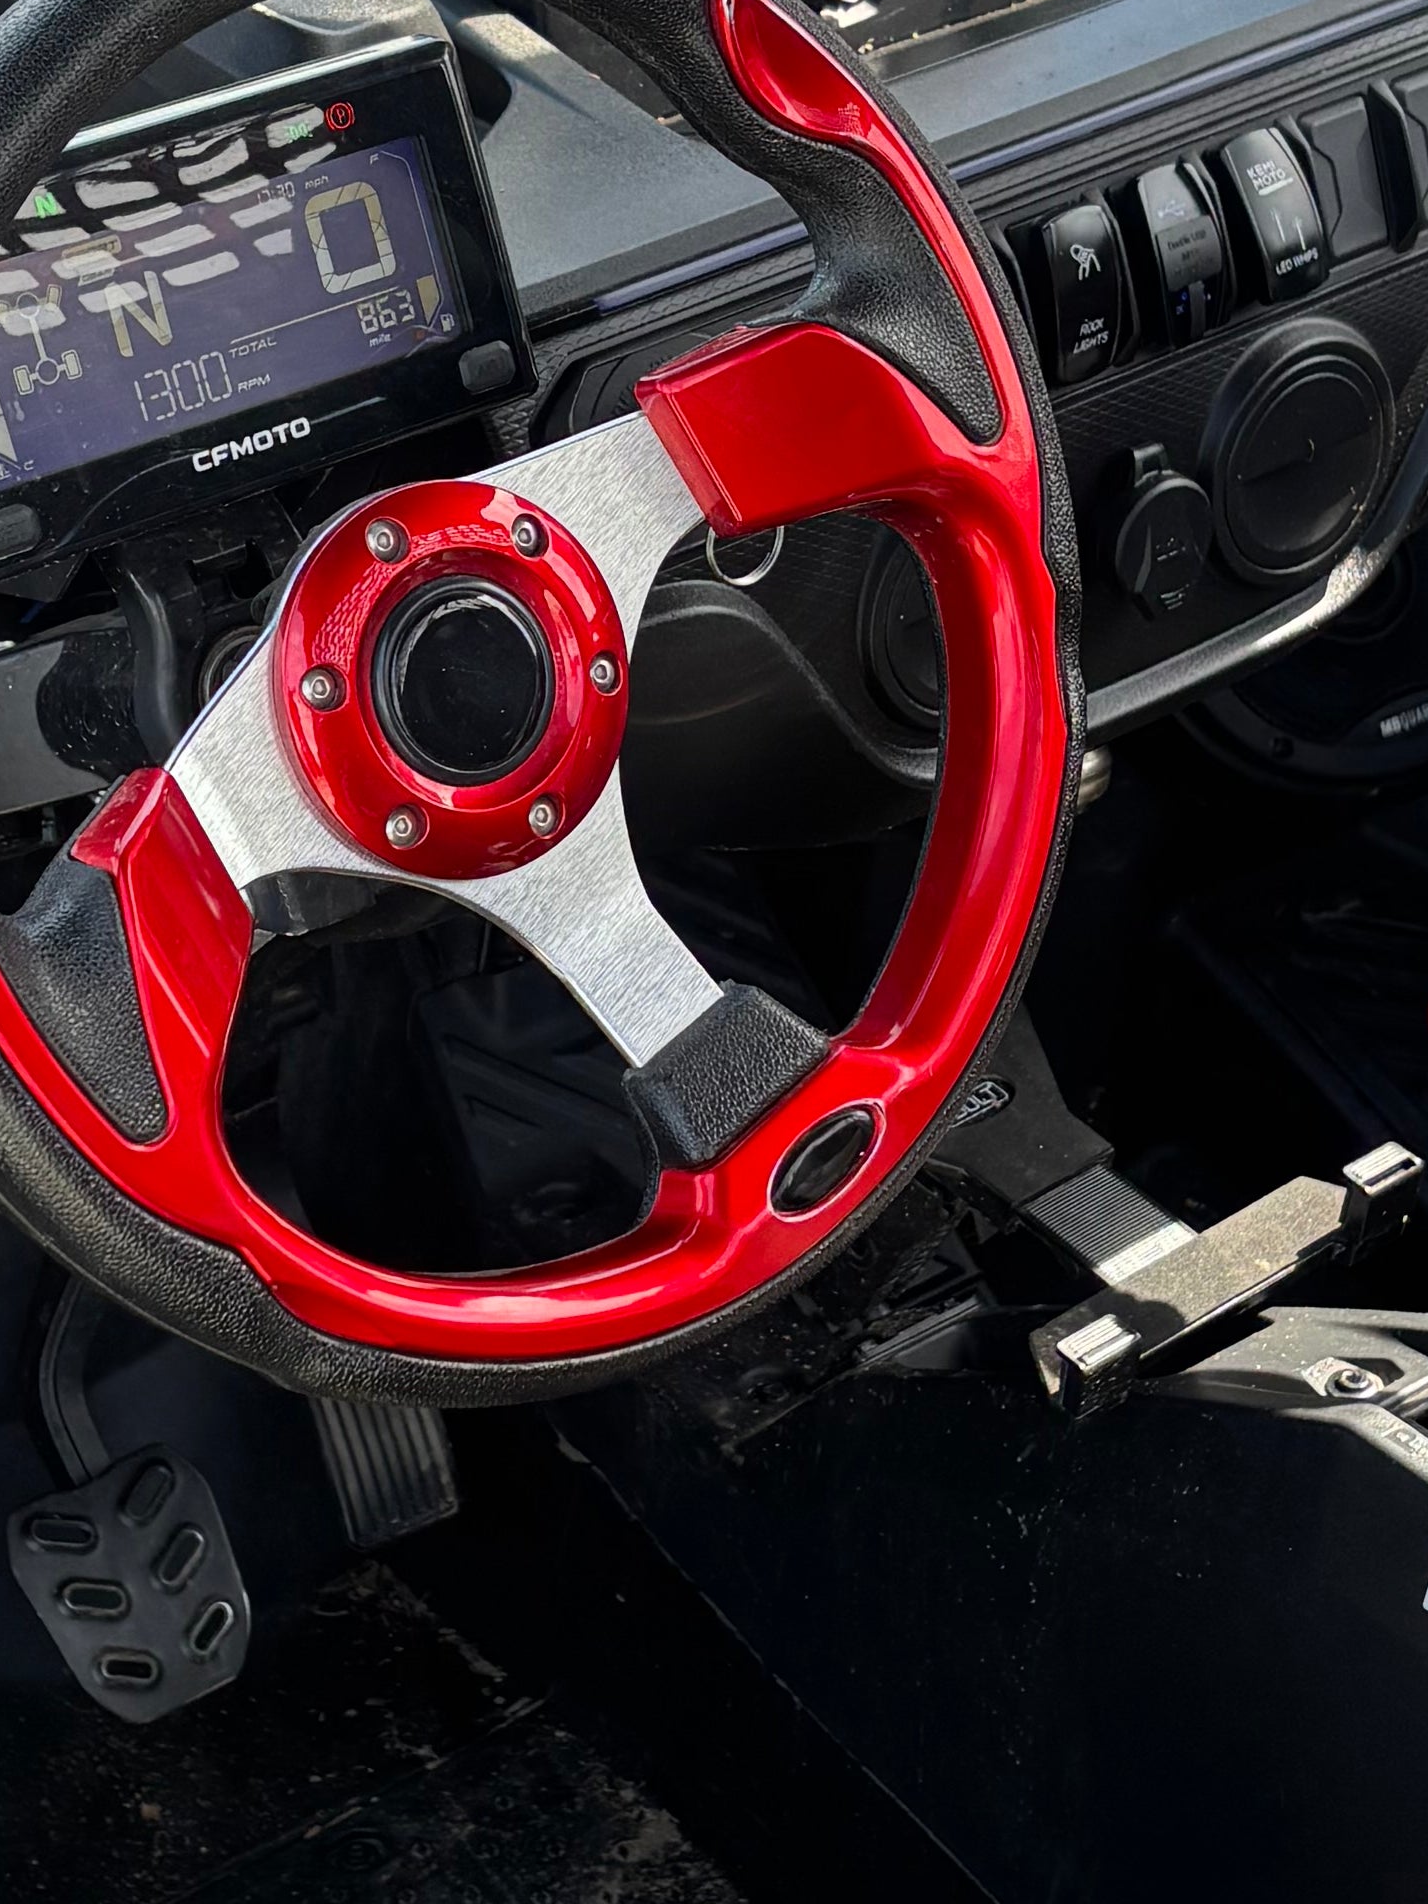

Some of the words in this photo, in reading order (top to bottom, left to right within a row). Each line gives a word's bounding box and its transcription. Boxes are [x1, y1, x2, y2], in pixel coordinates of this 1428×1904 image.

[1247, 160, 1276, 179] KEMI
[1252, 168, 1286, 190] MOTO
[305, 175, 329, 190] mph
[33, 192, 58, 219] N
[305, 181, 396, 293] 0
[104, 270, 172, 357] N
[356, 289, 415, 335] 863
[228, 336, 277, 359] TOTAL
[1073, 330, 1109, 354] LIGHTS
[134, 351, 233, 422] 1300
[237, 373, 271, 393] RPM
[192, 415, 311, 472] CFMOTO
